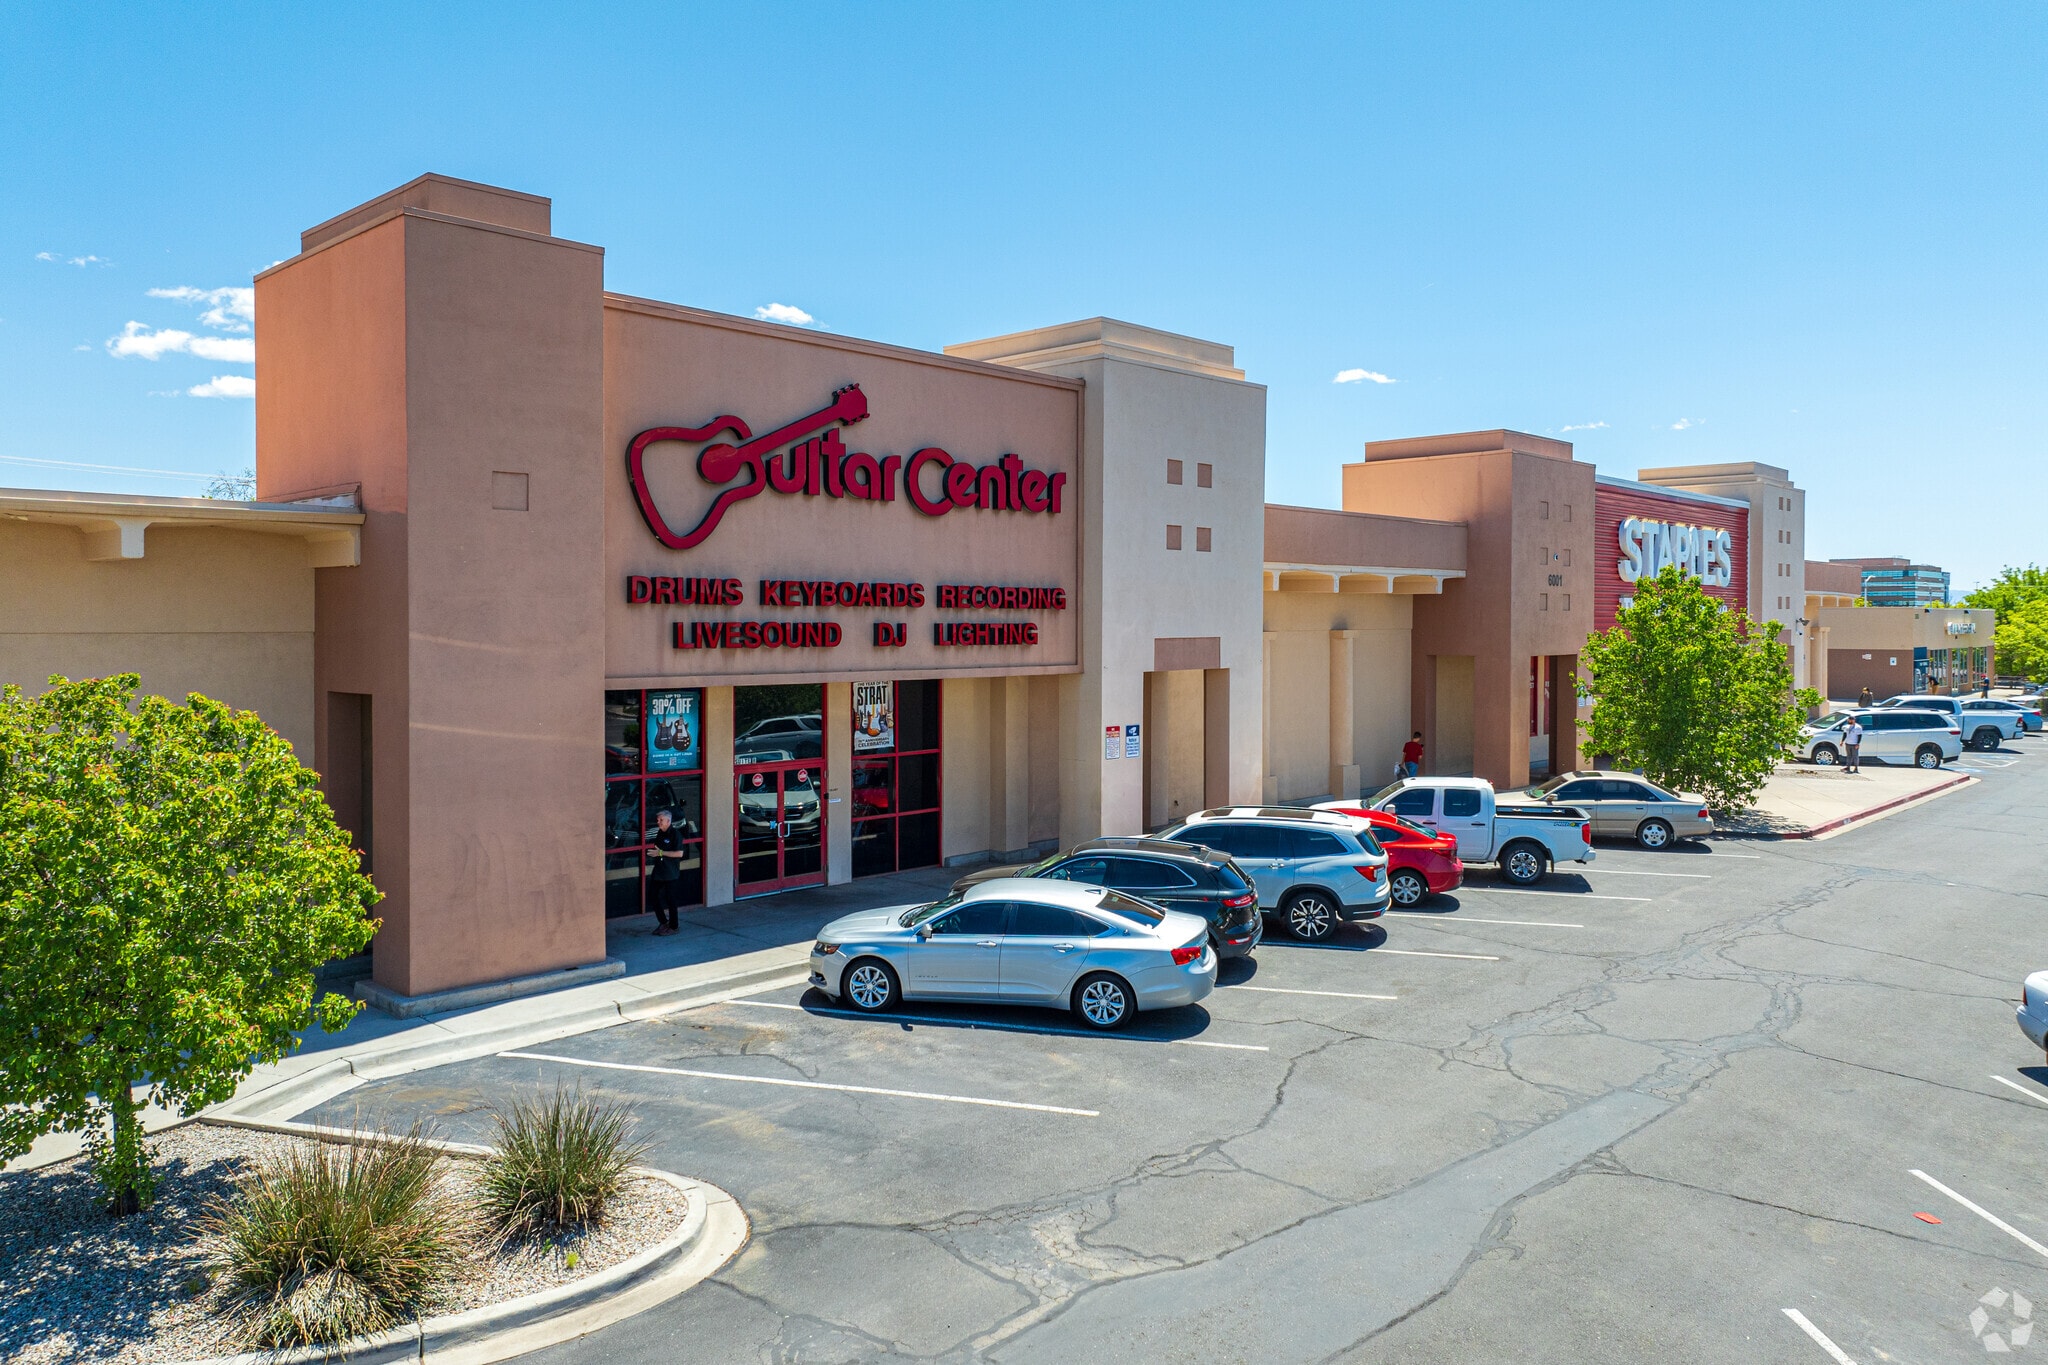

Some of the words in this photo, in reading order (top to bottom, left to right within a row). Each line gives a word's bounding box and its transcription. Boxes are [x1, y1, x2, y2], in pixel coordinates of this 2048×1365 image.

[626, 384, 901, 550] Guitar
[904, 447, 1067, 517] Center
[1617, 517, 1731, 587] STAPLES
[627, 575, 744, 605] DRUMS
[759, 579, 925, 608] KEYBOARDS
[937, 585, 1067, 610] RECORDING
[1548, 574, 1562, 587] 6001
[673, 622, 843, 649] LIVESOUND
[874, 622, 908, 648] DJ
[934, 622, 1039, 647] LIGHTING
[652, 699, 675, 715] 30%
[857, 686, 887, 705] STRAT
